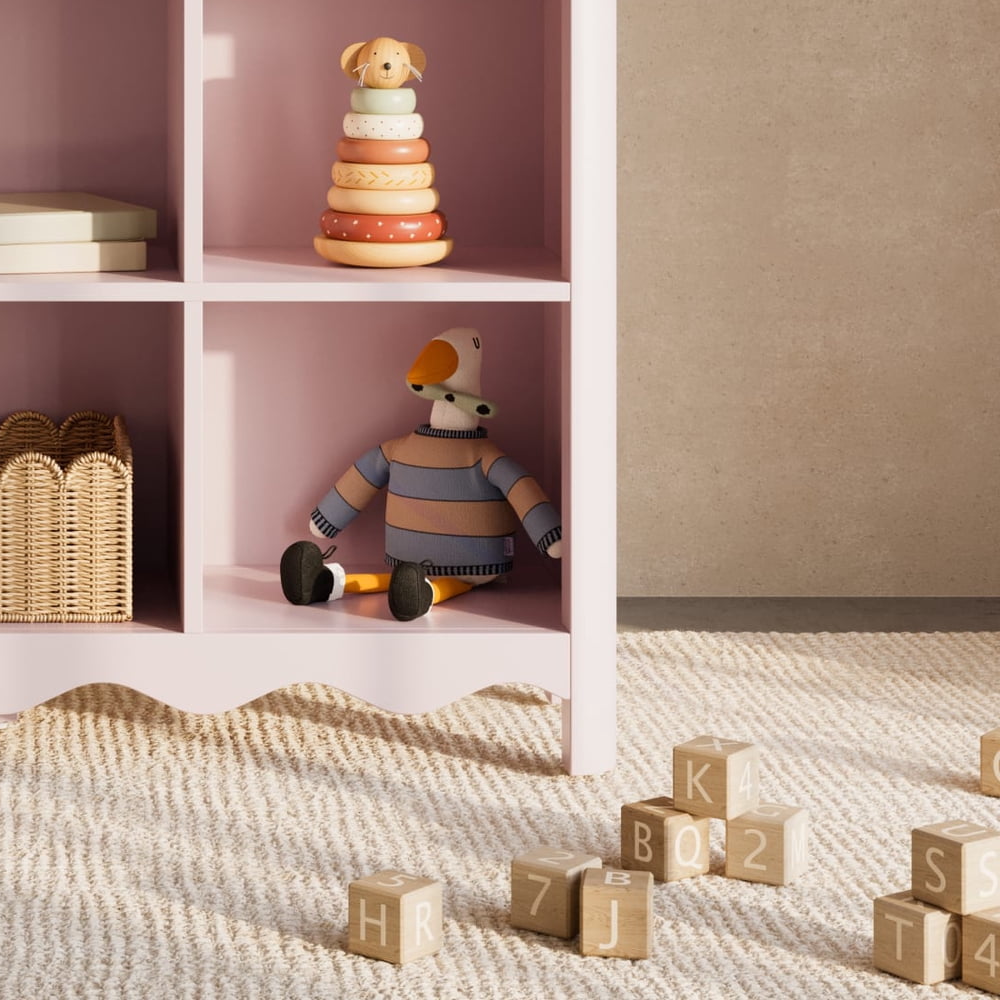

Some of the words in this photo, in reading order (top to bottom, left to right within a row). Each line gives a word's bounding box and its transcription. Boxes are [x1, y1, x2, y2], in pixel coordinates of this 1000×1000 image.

[686, 760, 713, 803] K
[738, 761, 753, 801] 4
[538, 851, 574, 865] 2
[634, 821, 653, 863] B
[675, 825, 703, 869] Q
[744, 829, 767, 871] 2
[604, 871, 631, 885] B
[925, 847, 946, 893] S
[979, 851, 998, 898] S
[527, 874, 551, 916] 7
[360, 899, 386, 946] H
[416, 901, 434, 946] R
[599, 900, 618, 949] J
[884, 914, 914, 960] T
[974, 933, 1000, 978] 4
